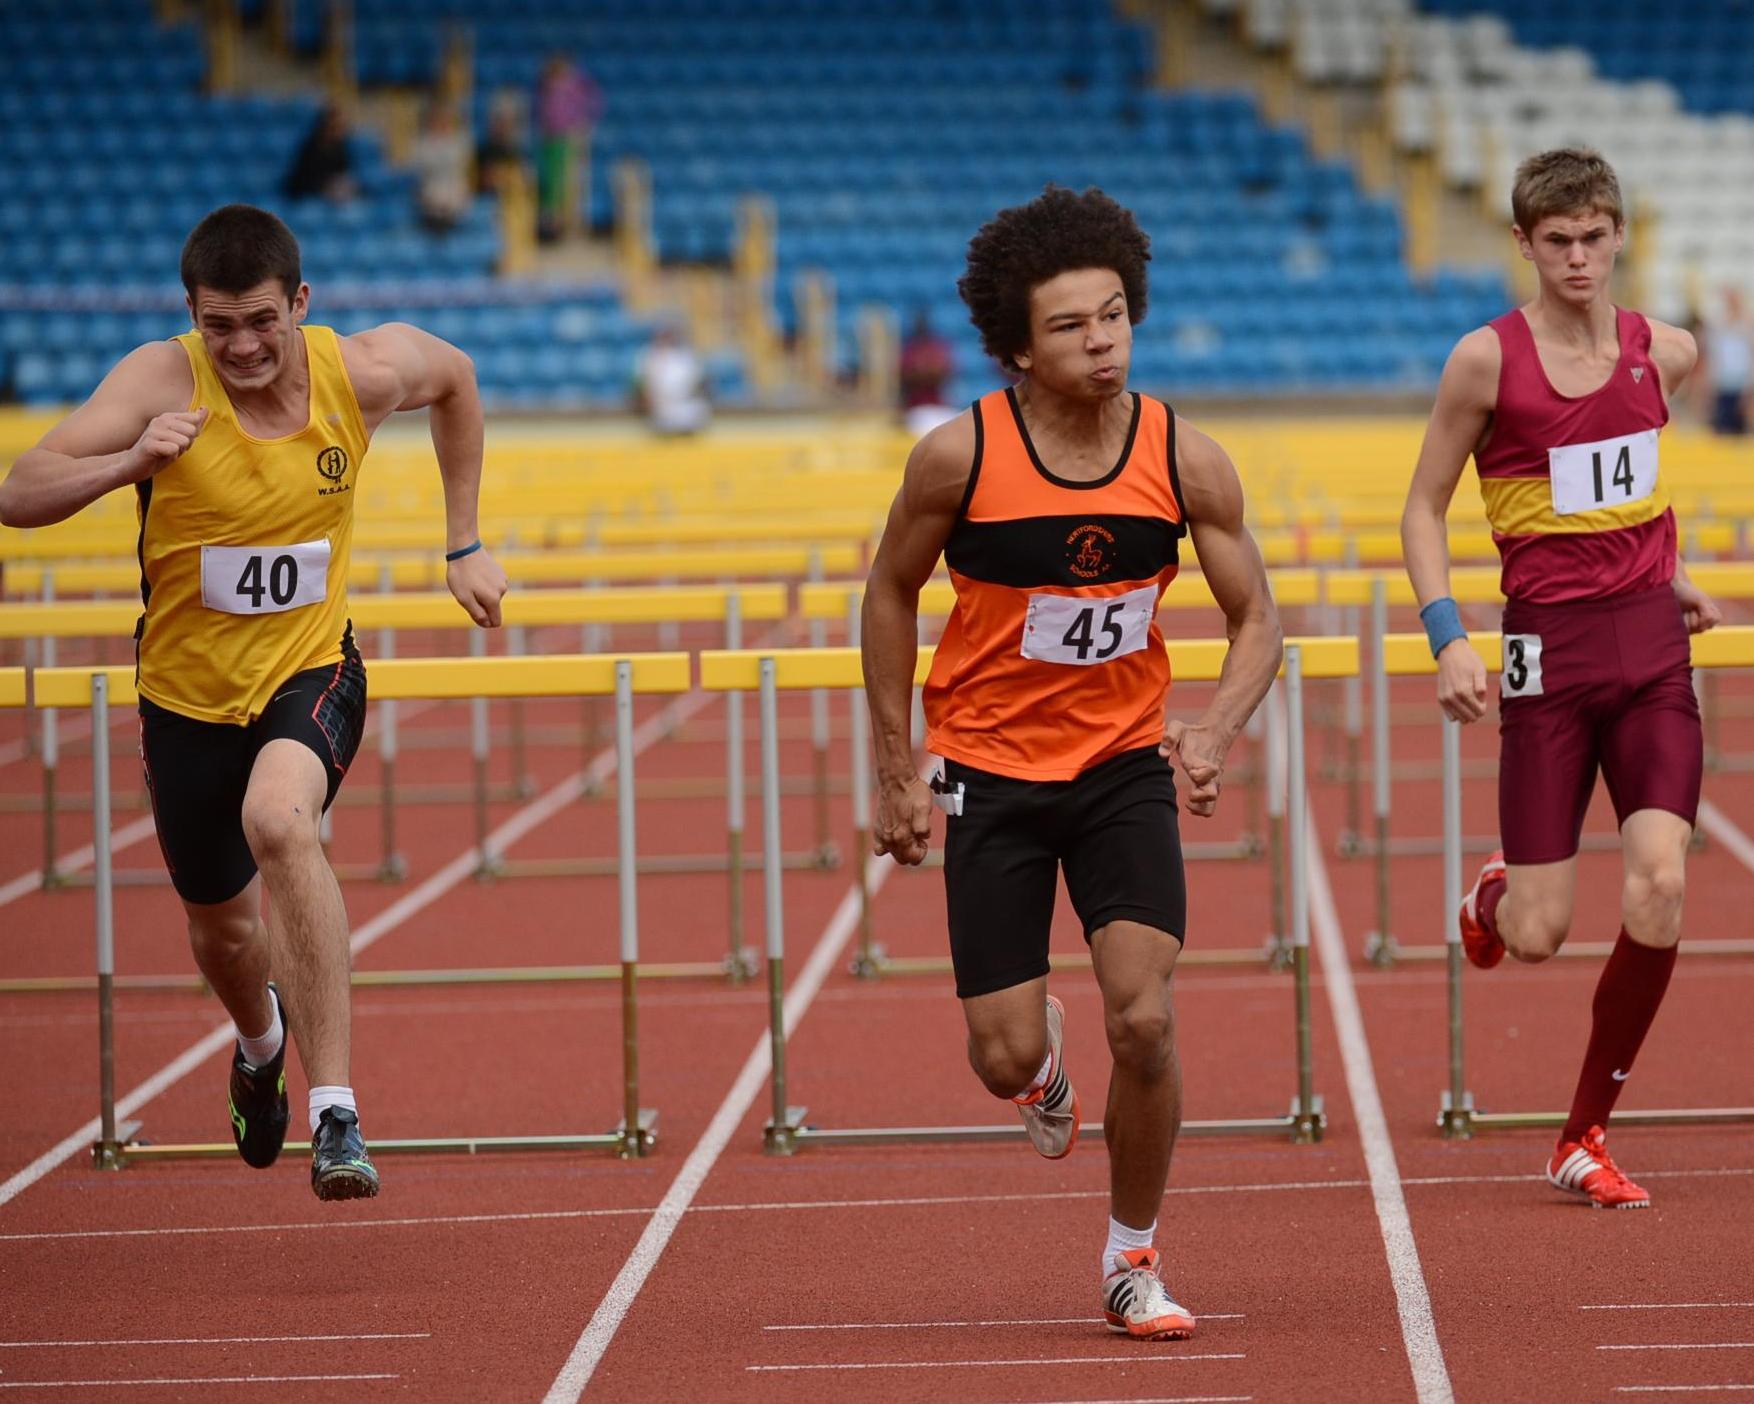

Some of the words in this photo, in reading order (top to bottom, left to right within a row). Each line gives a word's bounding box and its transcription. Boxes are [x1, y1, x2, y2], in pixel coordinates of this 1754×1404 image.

[1592, 445, 1635, 502] 14
[236, 554, 298, 608] 40
[1062, 602, 1126, 660] 45
[1507, 639, 1528, 690] 3
